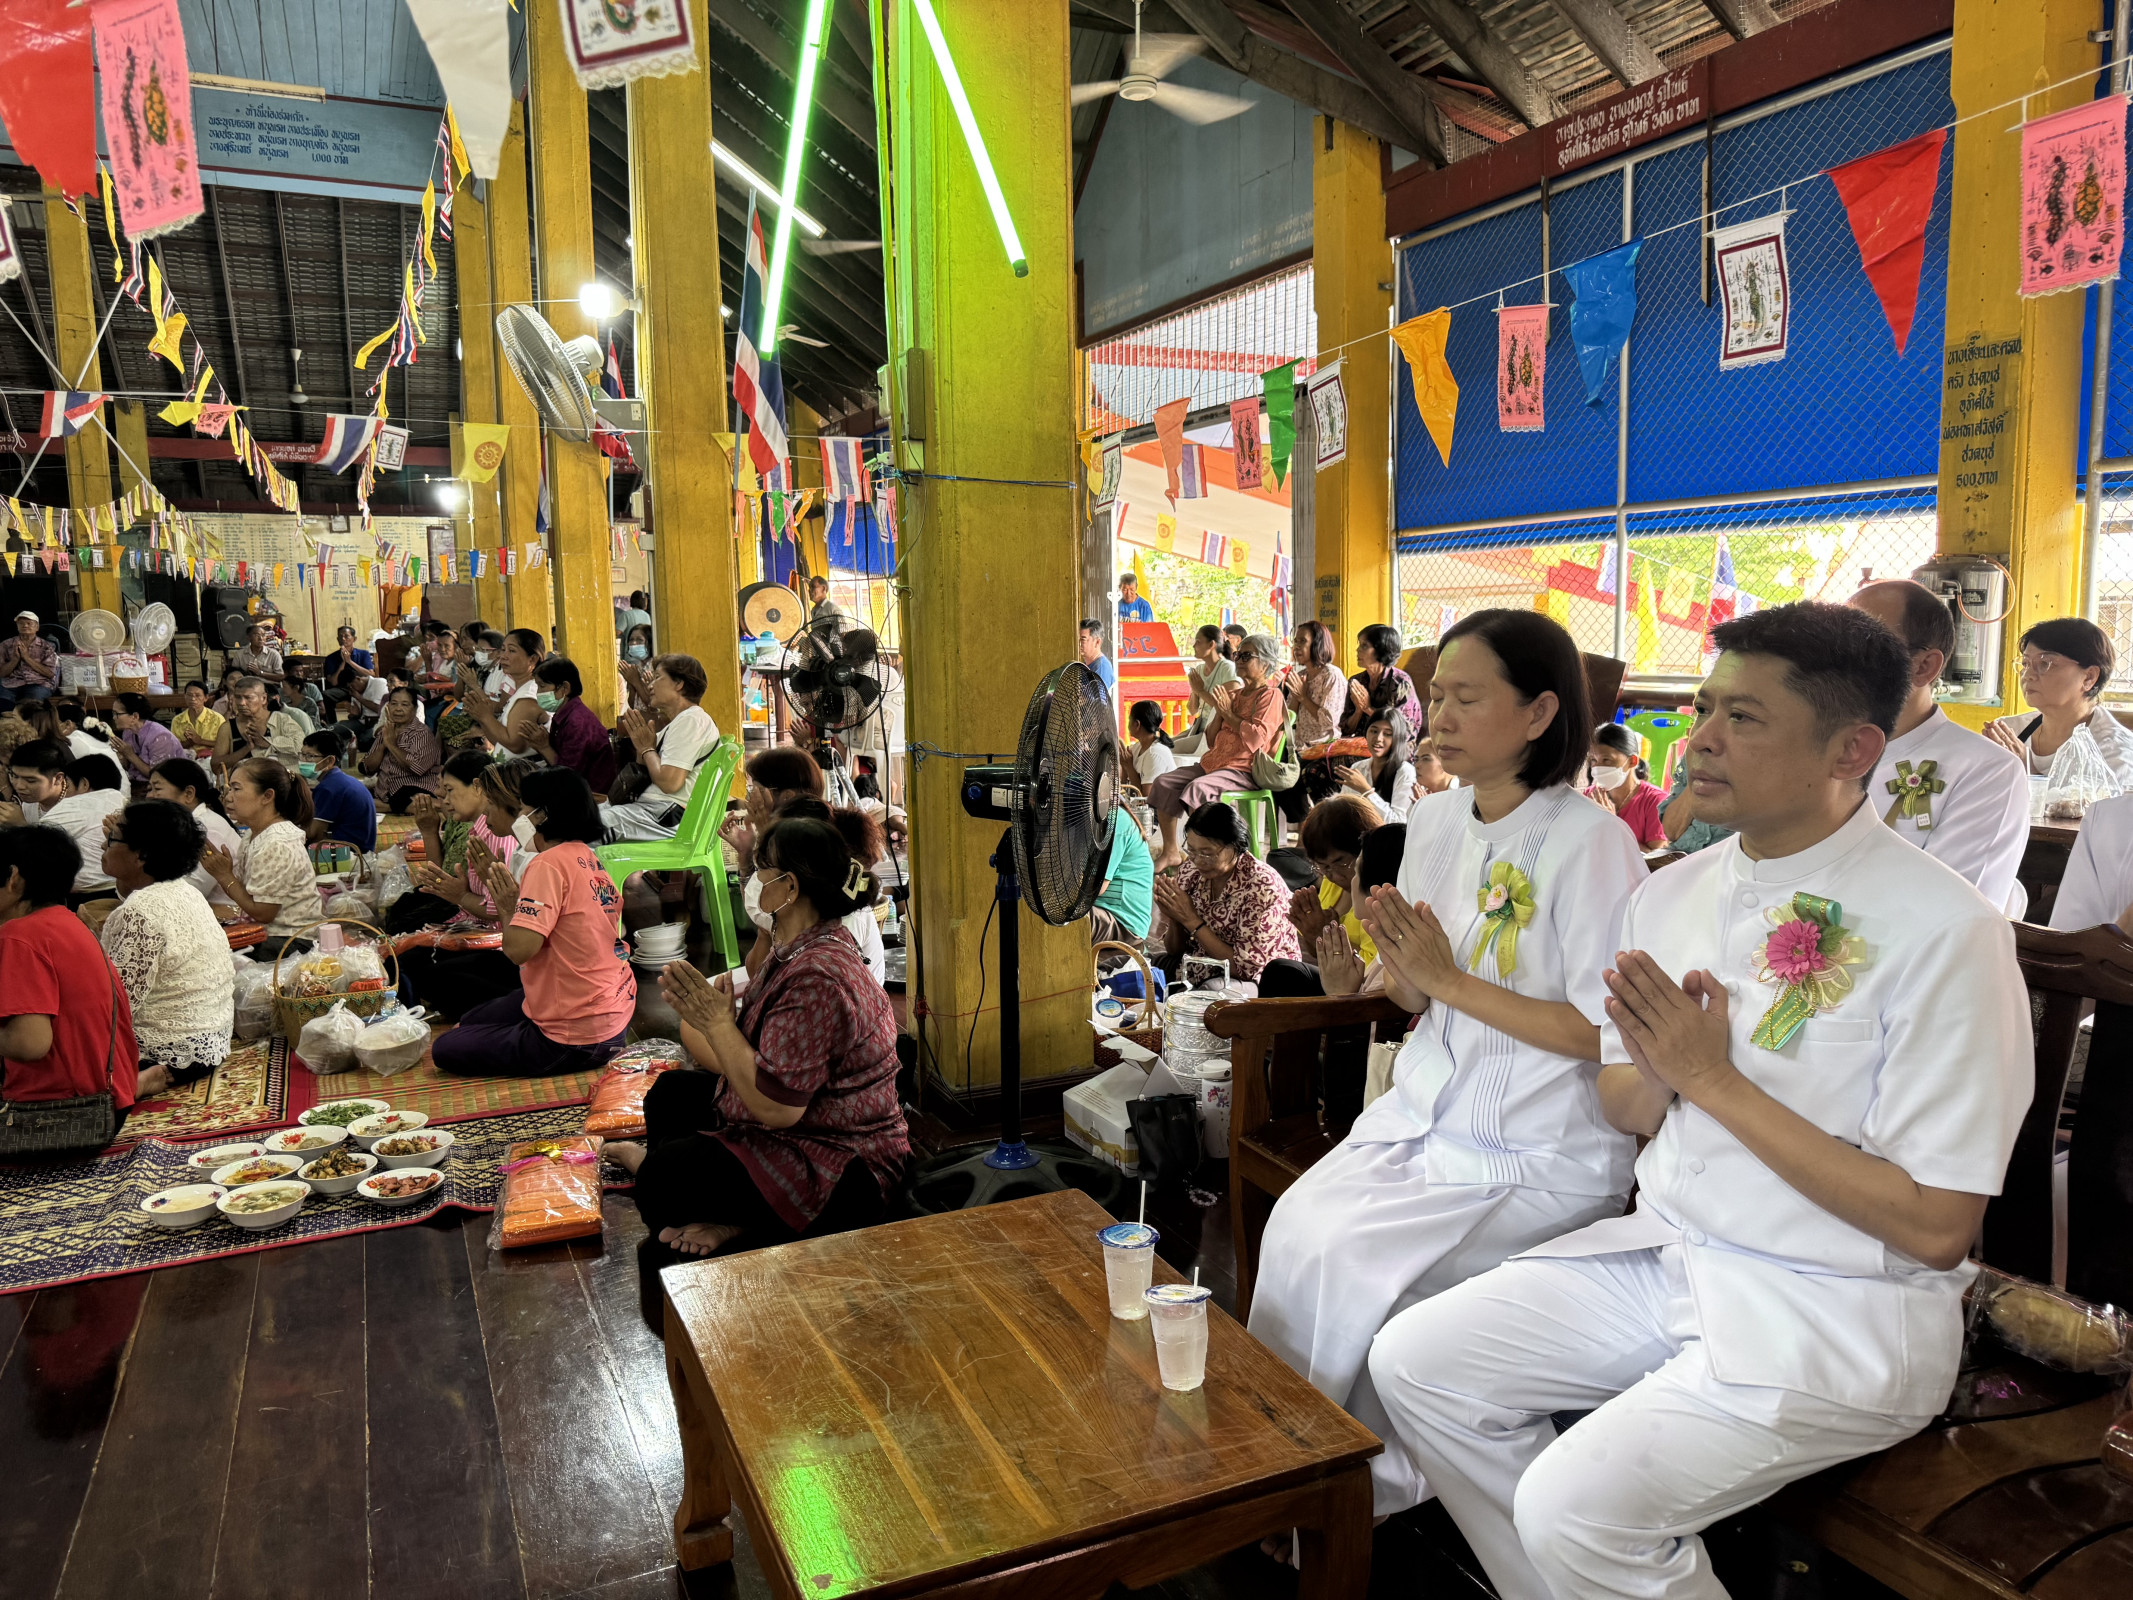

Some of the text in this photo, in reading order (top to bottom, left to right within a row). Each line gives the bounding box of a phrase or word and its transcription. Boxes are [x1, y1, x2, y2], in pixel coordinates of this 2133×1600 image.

[1651, 107, 1674, 130] 300
[1676, 96, 1700, 122] บาท
[311, 153, 332, 163] 1,000
[333, 155, 349, 165] บาท
[1947, 372, 1964, 390] ครัว
